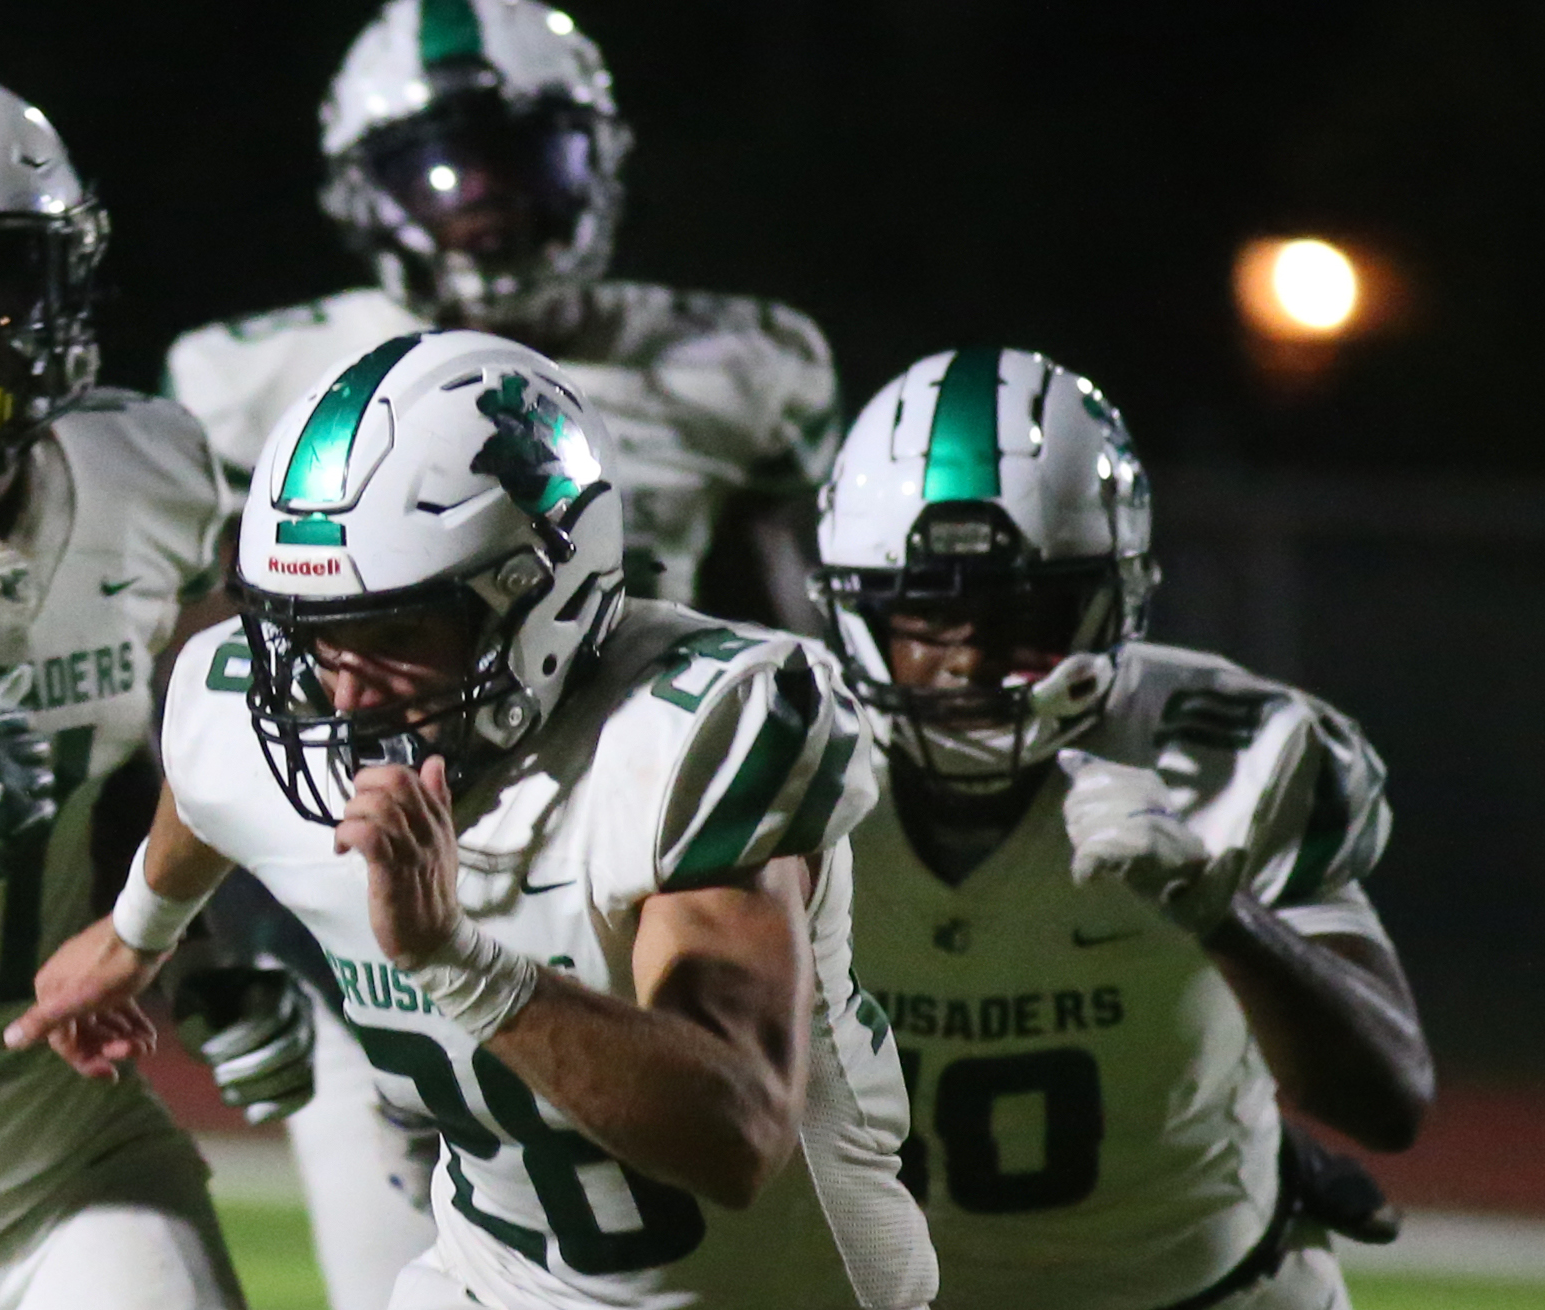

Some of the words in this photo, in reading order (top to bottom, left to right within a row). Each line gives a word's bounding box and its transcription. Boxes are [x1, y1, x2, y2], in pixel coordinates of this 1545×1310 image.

[268, 556, 342, 576] Riddell
[875, 985, 1125, 1042] USADERS
[355, 1024, 706, 1275] 28
[895, 1048, 1105, 1213] 0
